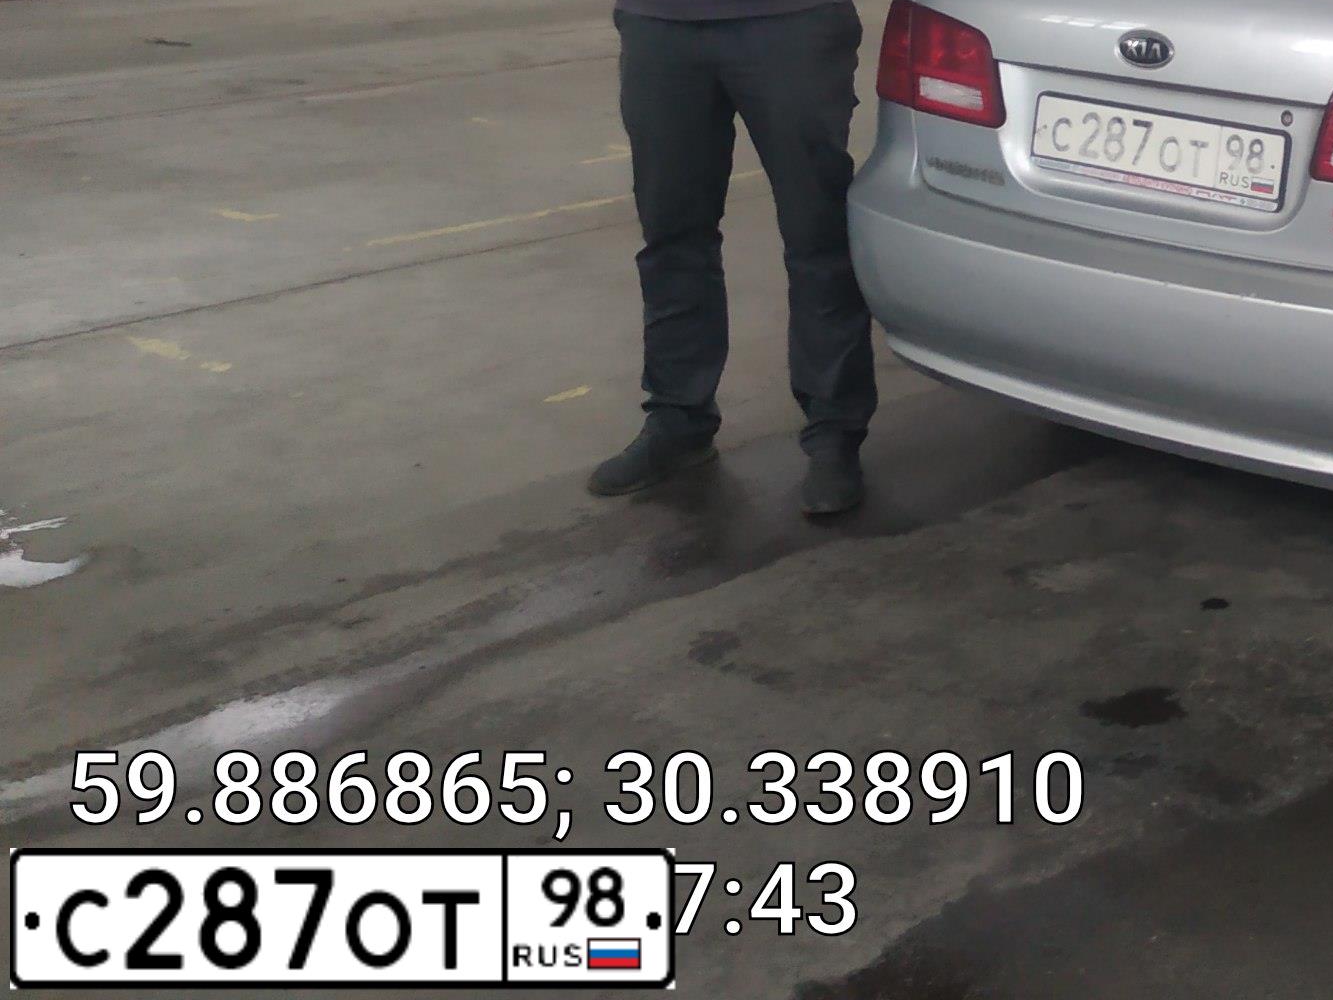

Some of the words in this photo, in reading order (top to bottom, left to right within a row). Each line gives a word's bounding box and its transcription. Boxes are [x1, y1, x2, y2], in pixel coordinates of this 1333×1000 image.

[1124, 39, 1162, 59] KIA
[1225, 134, 1265, 174] 98
[1218, 172, 1250, 189] RUS
